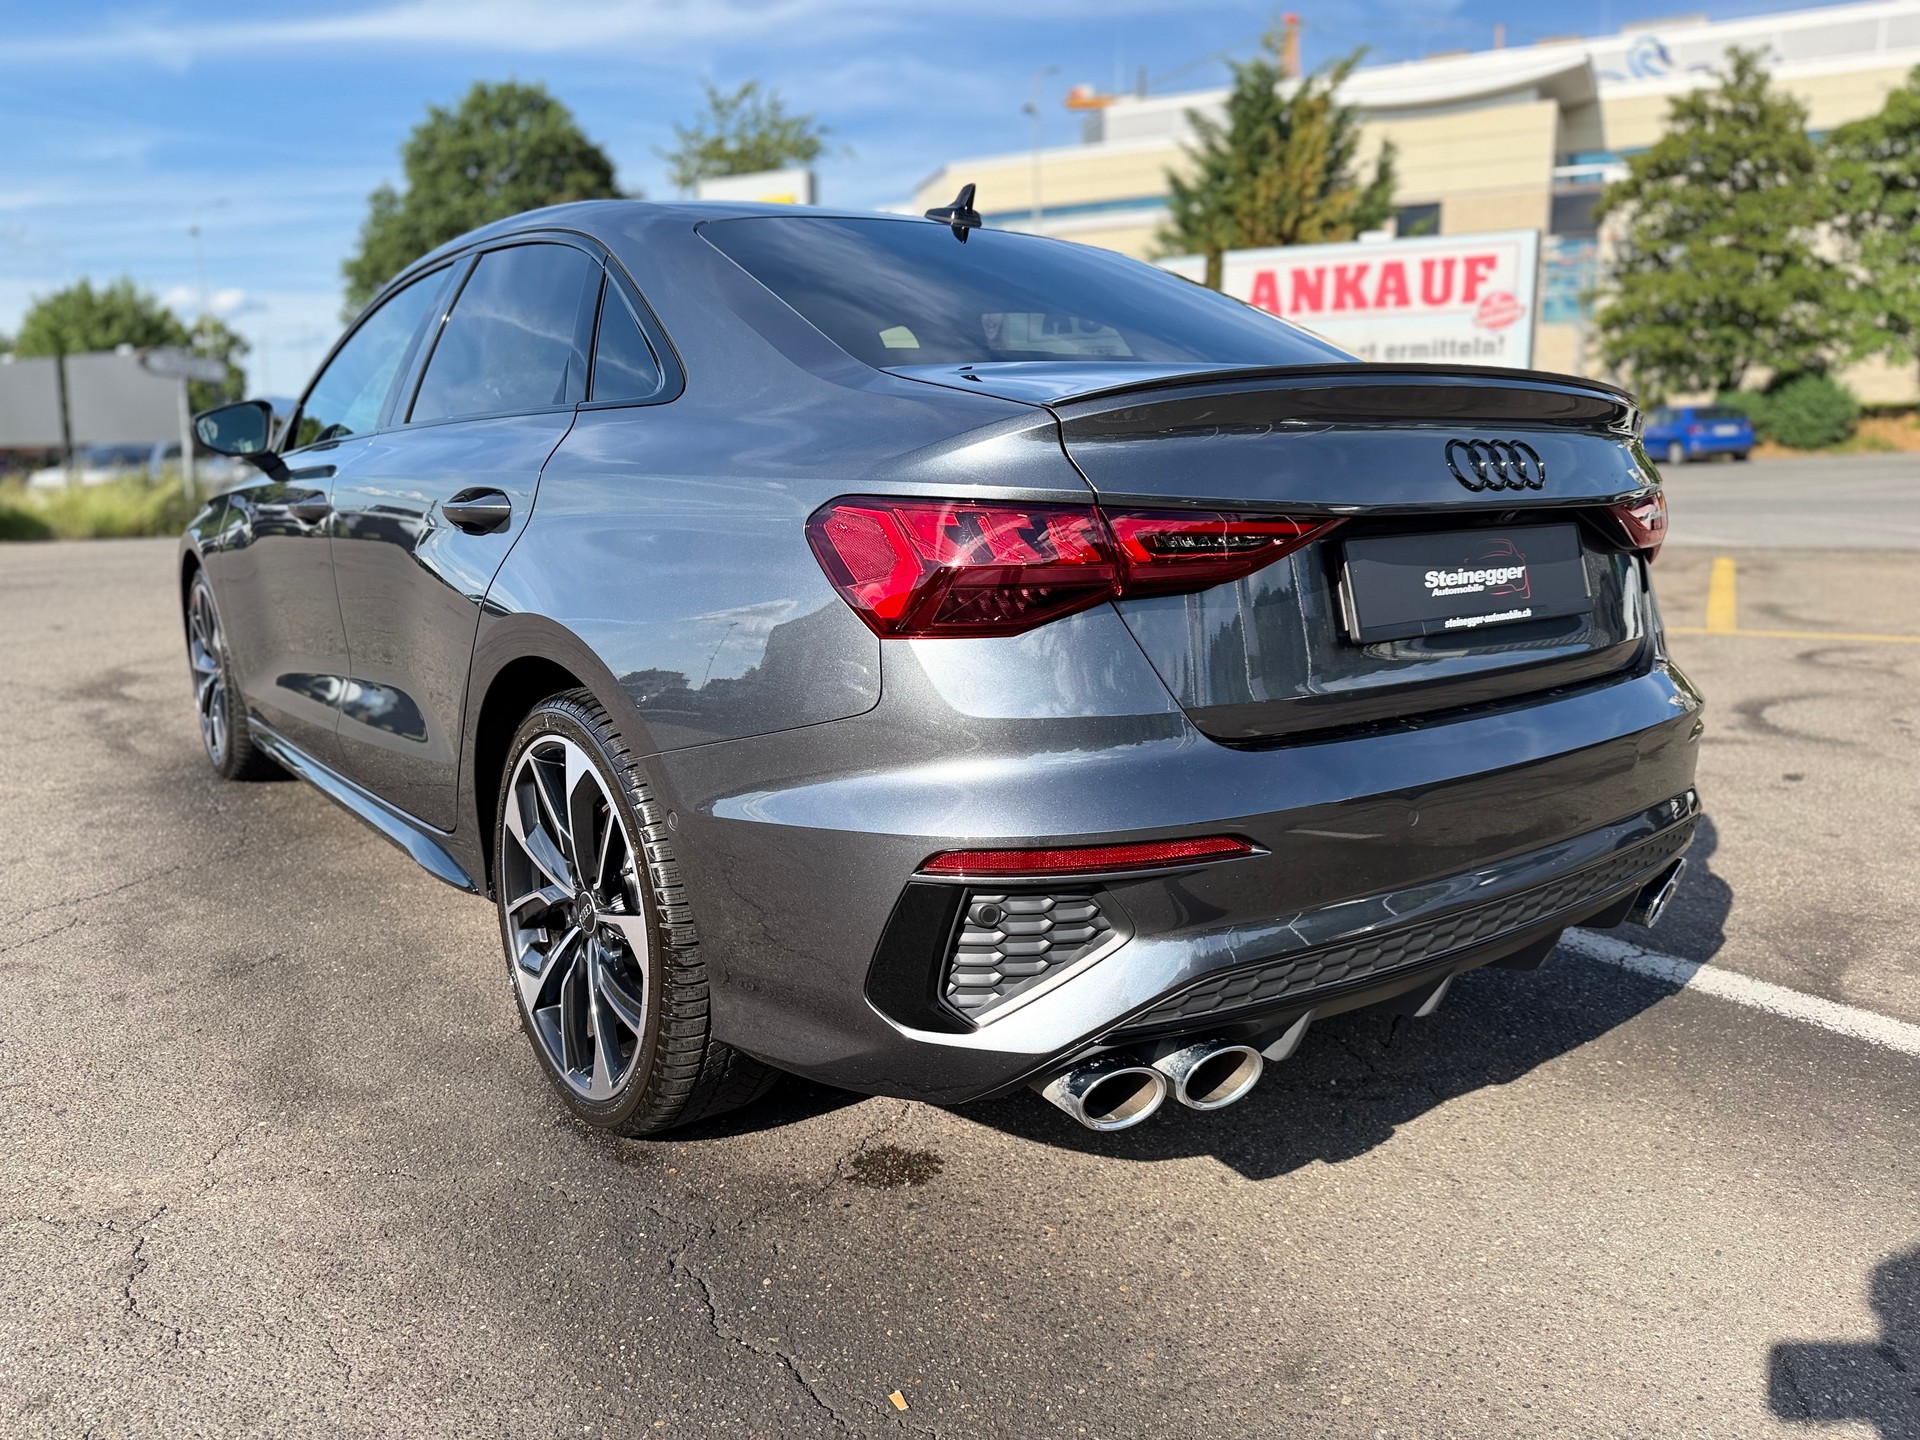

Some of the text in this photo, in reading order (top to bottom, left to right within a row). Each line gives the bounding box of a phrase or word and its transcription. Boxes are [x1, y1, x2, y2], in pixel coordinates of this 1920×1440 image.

[1249, 256, 1497, 317] ANKAUF
[1424, 566, 1526, 588] Steinegger
[1431, 585, 1485, 597] Automobile
[1444, 607, 1532, 628] steinegger-automobile.ch
